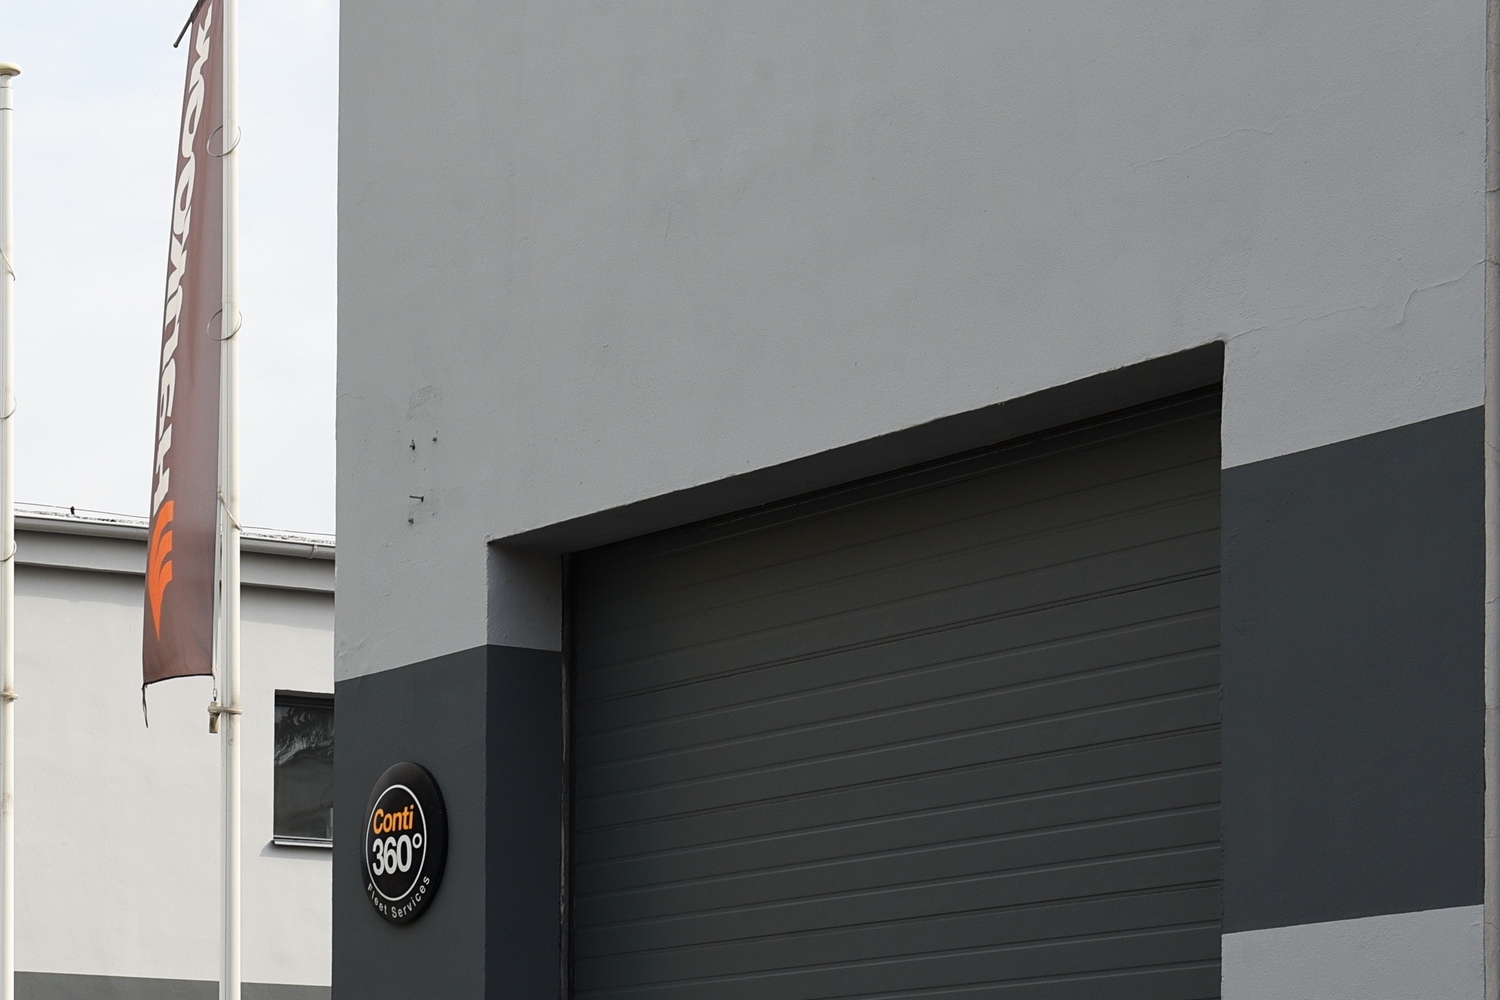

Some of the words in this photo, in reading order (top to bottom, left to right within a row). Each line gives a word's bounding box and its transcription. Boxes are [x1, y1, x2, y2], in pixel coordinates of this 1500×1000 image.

[373, 805, 414, 834] Conti
[367, 882, 388, 915] Fleet
[391, 875, 431, 919] Services
